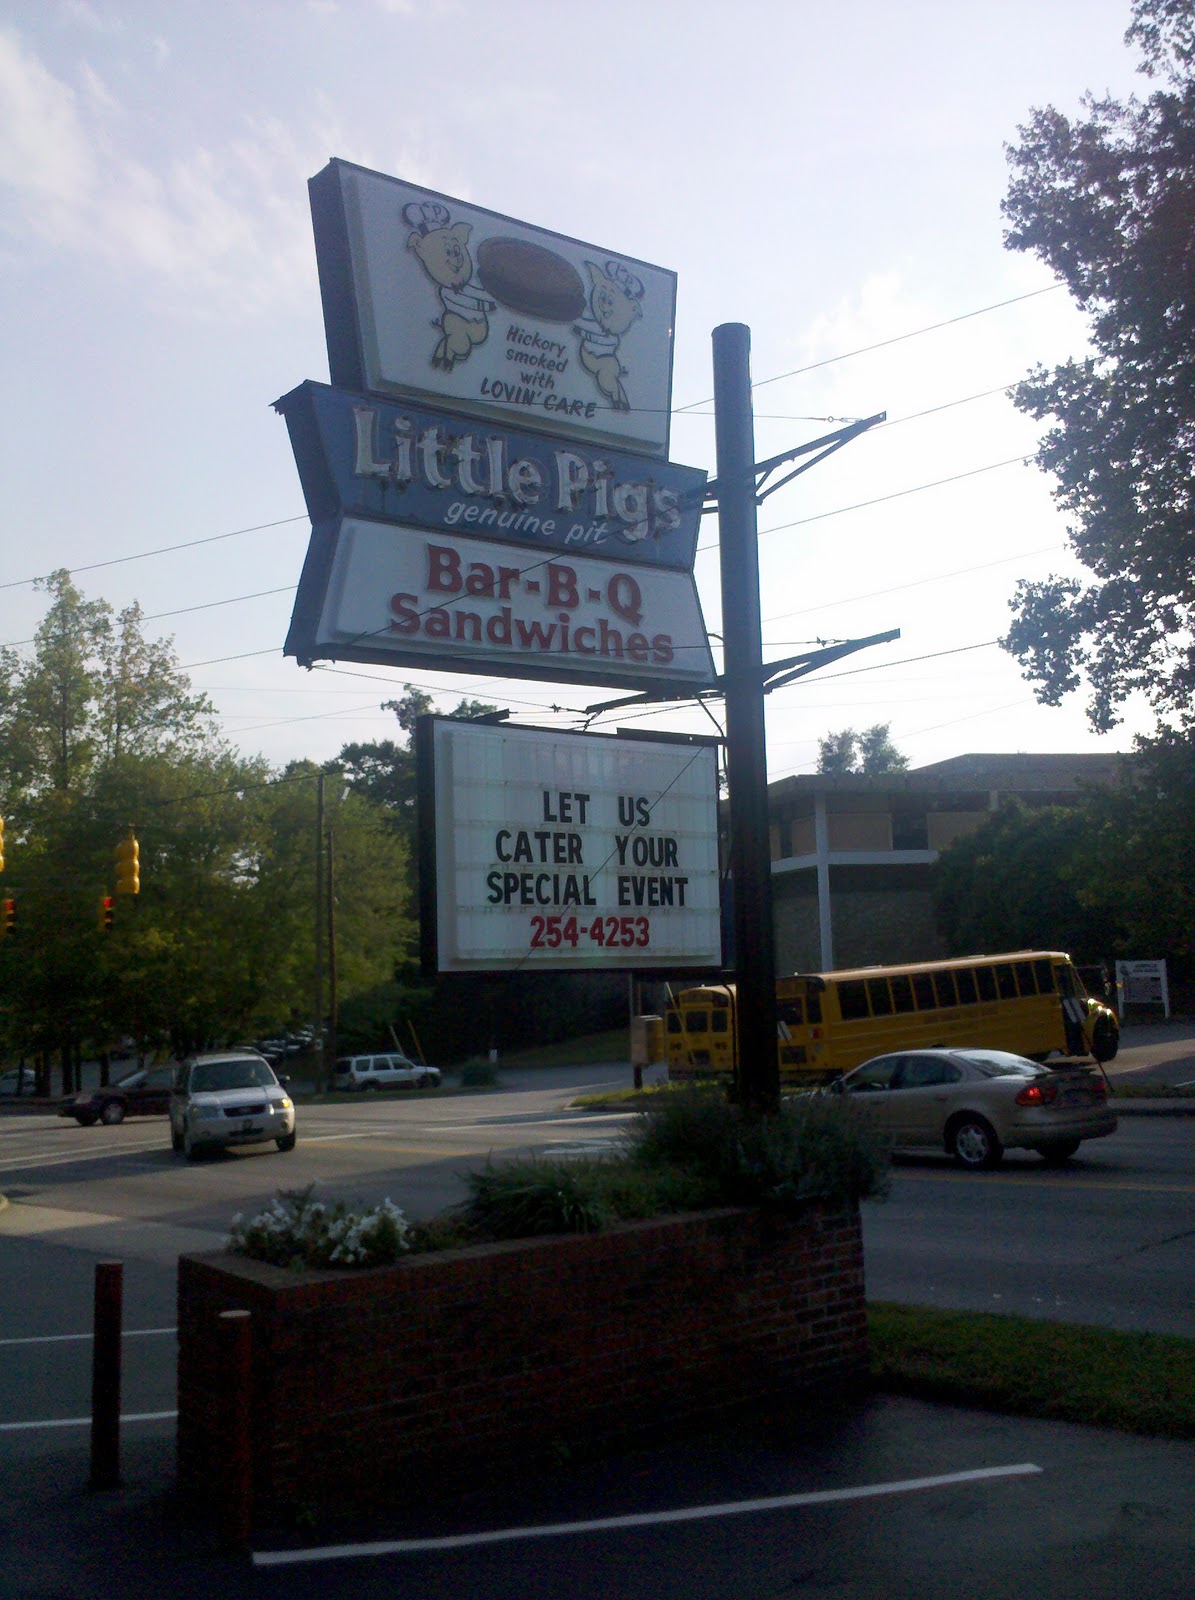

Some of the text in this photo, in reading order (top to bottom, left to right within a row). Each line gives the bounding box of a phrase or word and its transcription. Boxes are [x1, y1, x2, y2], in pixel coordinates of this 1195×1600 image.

[506, 325, 566, 358] Hickory
[505, 349, 568, 373] smoked
[480, 377, 597, 419] LOVIN' CARE
[520, 371, 555, 390] with
[353, 407, 681, 541] Little Pigs
[444, 502, 607, 544] genuine pit
[427, 543, 643, 626] Bar-B-Q
[390, 592, 675, 663] Sandwiches
[543, 791, 650, 827] LET US
[495, 830, 679, 867] CATER YOUR
[486, 871, 688, 906] SPECIAL EVENT
[530, 915, 650, 948] 254-4253
